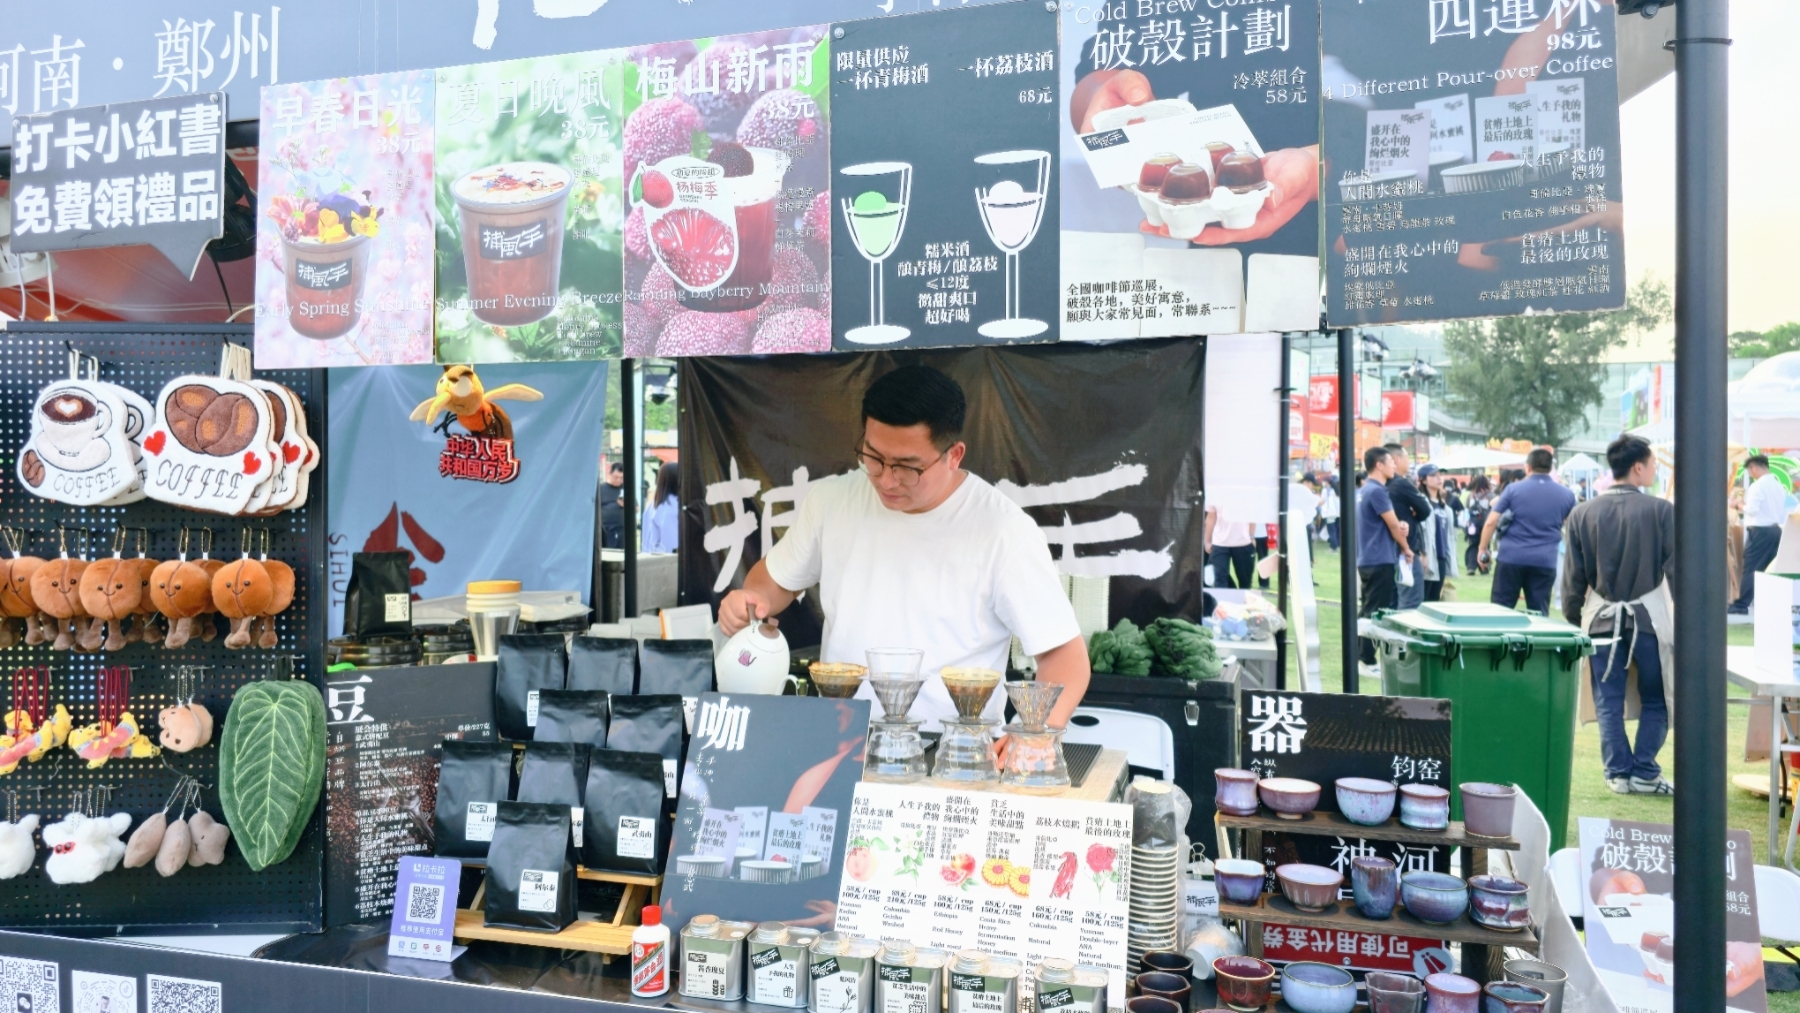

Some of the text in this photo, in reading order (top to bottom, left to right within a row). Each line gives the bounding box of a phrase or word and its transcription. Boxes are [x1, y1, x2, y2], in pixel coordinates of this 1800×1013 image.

[1076, 3, 1127, 24] Cold
[1089, 5, 1291, 71] 破殼計劃
[1547, 27, 1601, 51] 98元
[636, 40, 816, 102] 梅山新雨
[837, 46, 909, 71] 限量供应
[958, 50, 1053, 78] 一杯荔枝酒
[837, 63, 928, 90] 一杯青梅酒
[1342, 78, 1429, 99] Different
[1437, 64, 1539, 87] Pour-over
[1547, 57, 1612, 75] Coffee
[449, 67, 611, 125] 夏日晚風
[762, 94, 814, 119] 38元
[1019, 86, 1052, 104] 68元
[1266, 86, 1306, 104] 58元
[272, 84, 422, 137] 早春日光
[15, 104, 221, 173] 打卡小紅書
[561, 115, 609, 140] 38元
[1371, 123, 1401, 136] 盛开在
[376, 132, 422, 155] 38元
[1370, 135, 1410, 148] 我心中的
[15, 170, 218, 236] 免費領禮品
[676, 180, 718, 201] 杨梅季
[925, 241, 970, 259] 糯米酒
[1345, 240, 1458, 262] 盛開在我心中的
[1521, 245, 1608, 264] 最後的玫瑰
[504, 292, 566, 310] Evening
[691, 286, 753, 301] Bayberry
[759, 281, 830, 296] Mountain
[918, 291, 977, 309] 微甜爽口
[300, 301, 349, 318] Spring
[925, 309, 970, 325] 超好喝
[446, 438, 513, 461] 中华人民
[156, 459, 243, 500] COFFEE
[439, 455, 517, 481] 共和国万岁
[54, 467, 121, 499] COFFEE
[327, 675, 375, 725] 豆
[697, 696, 750, 751] 咖
[1247, 695, 1307, 754] 器
[1391, 755, 1442, 781] 钧窑
[1589, 826, 1672, 843] Cold Brew
[1263, 926, 1411, 960] 可使用代金券
